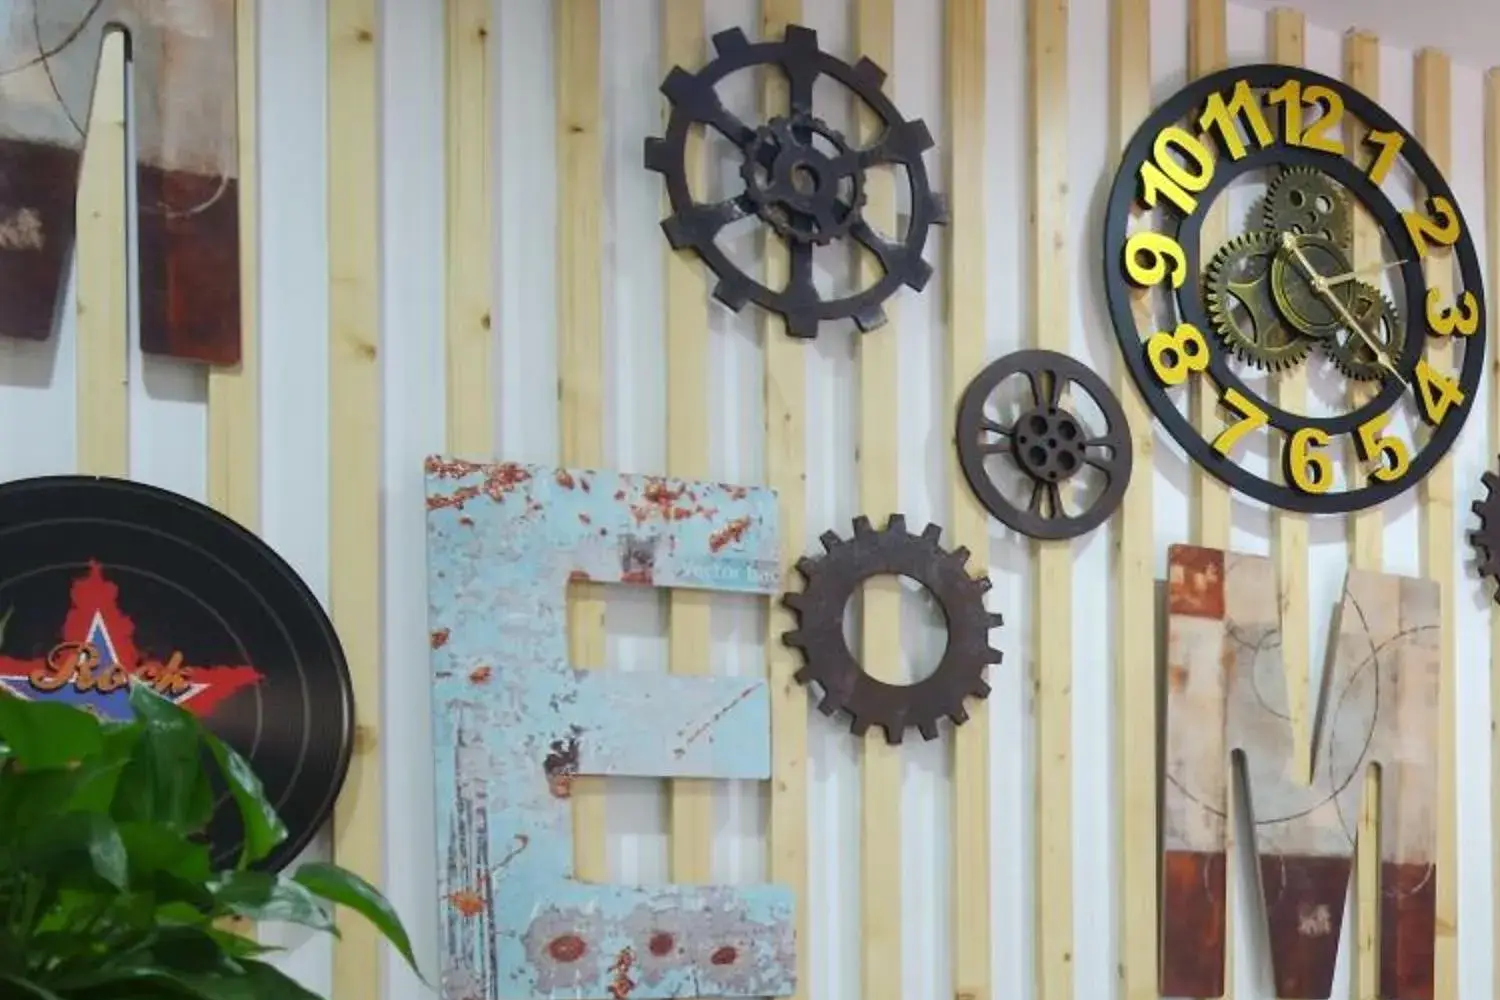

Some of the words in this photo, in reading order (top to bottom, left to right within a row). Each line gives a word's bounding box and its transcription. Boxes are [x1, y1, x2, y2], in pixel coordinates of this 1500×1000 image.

[1200, 80, 1274, 160] 11
[1269, 79, 1344, 156] 12
[1139, 126, 1216, 216] 10
[1365, 129, 1405, 186] 1
[1402, 196, 1460, 257] 2
[1126, 232, 1186, 288] 9
[1426, 288, 1478, 337] 3
[1148, 323, 1210, 385] 8
[1213, 388, 1269, 454] 7
[1416, 360, 1464, 425] 4
[1289, 427, 1333, 494] 6
[1359, 413, 1408, 481] 5
